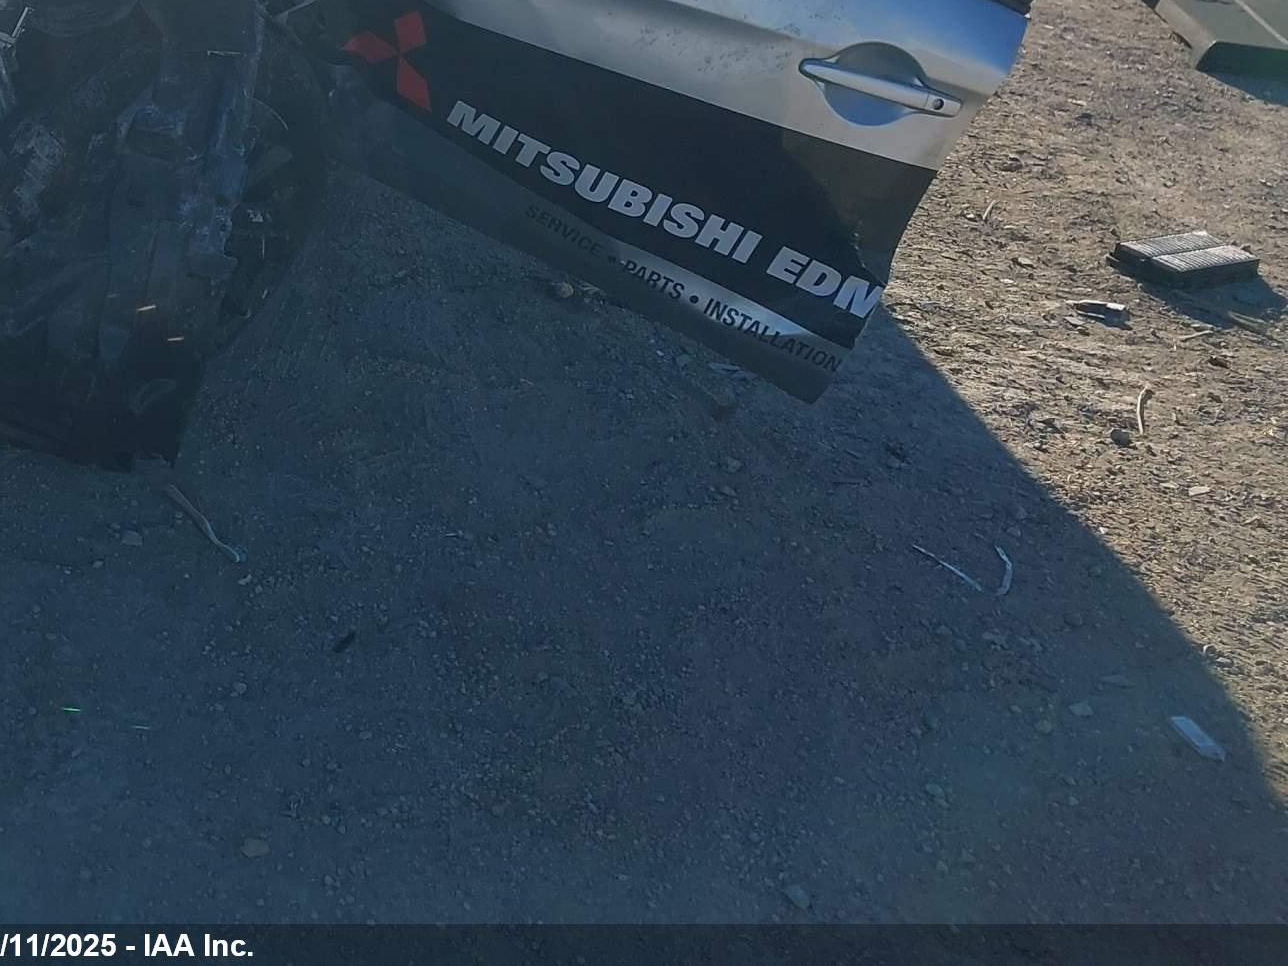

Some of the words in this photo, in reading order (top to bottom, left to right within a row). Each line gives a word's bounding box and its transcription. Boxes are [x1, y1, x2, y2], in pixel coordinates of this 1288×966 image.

[446, 99, 764, 264] MITSUBISHI
[525, 204, 602, 257] SERVICE
[622, 259, 685, 300] PARTS
[703, 297, 843, 372] INSTALLATION
